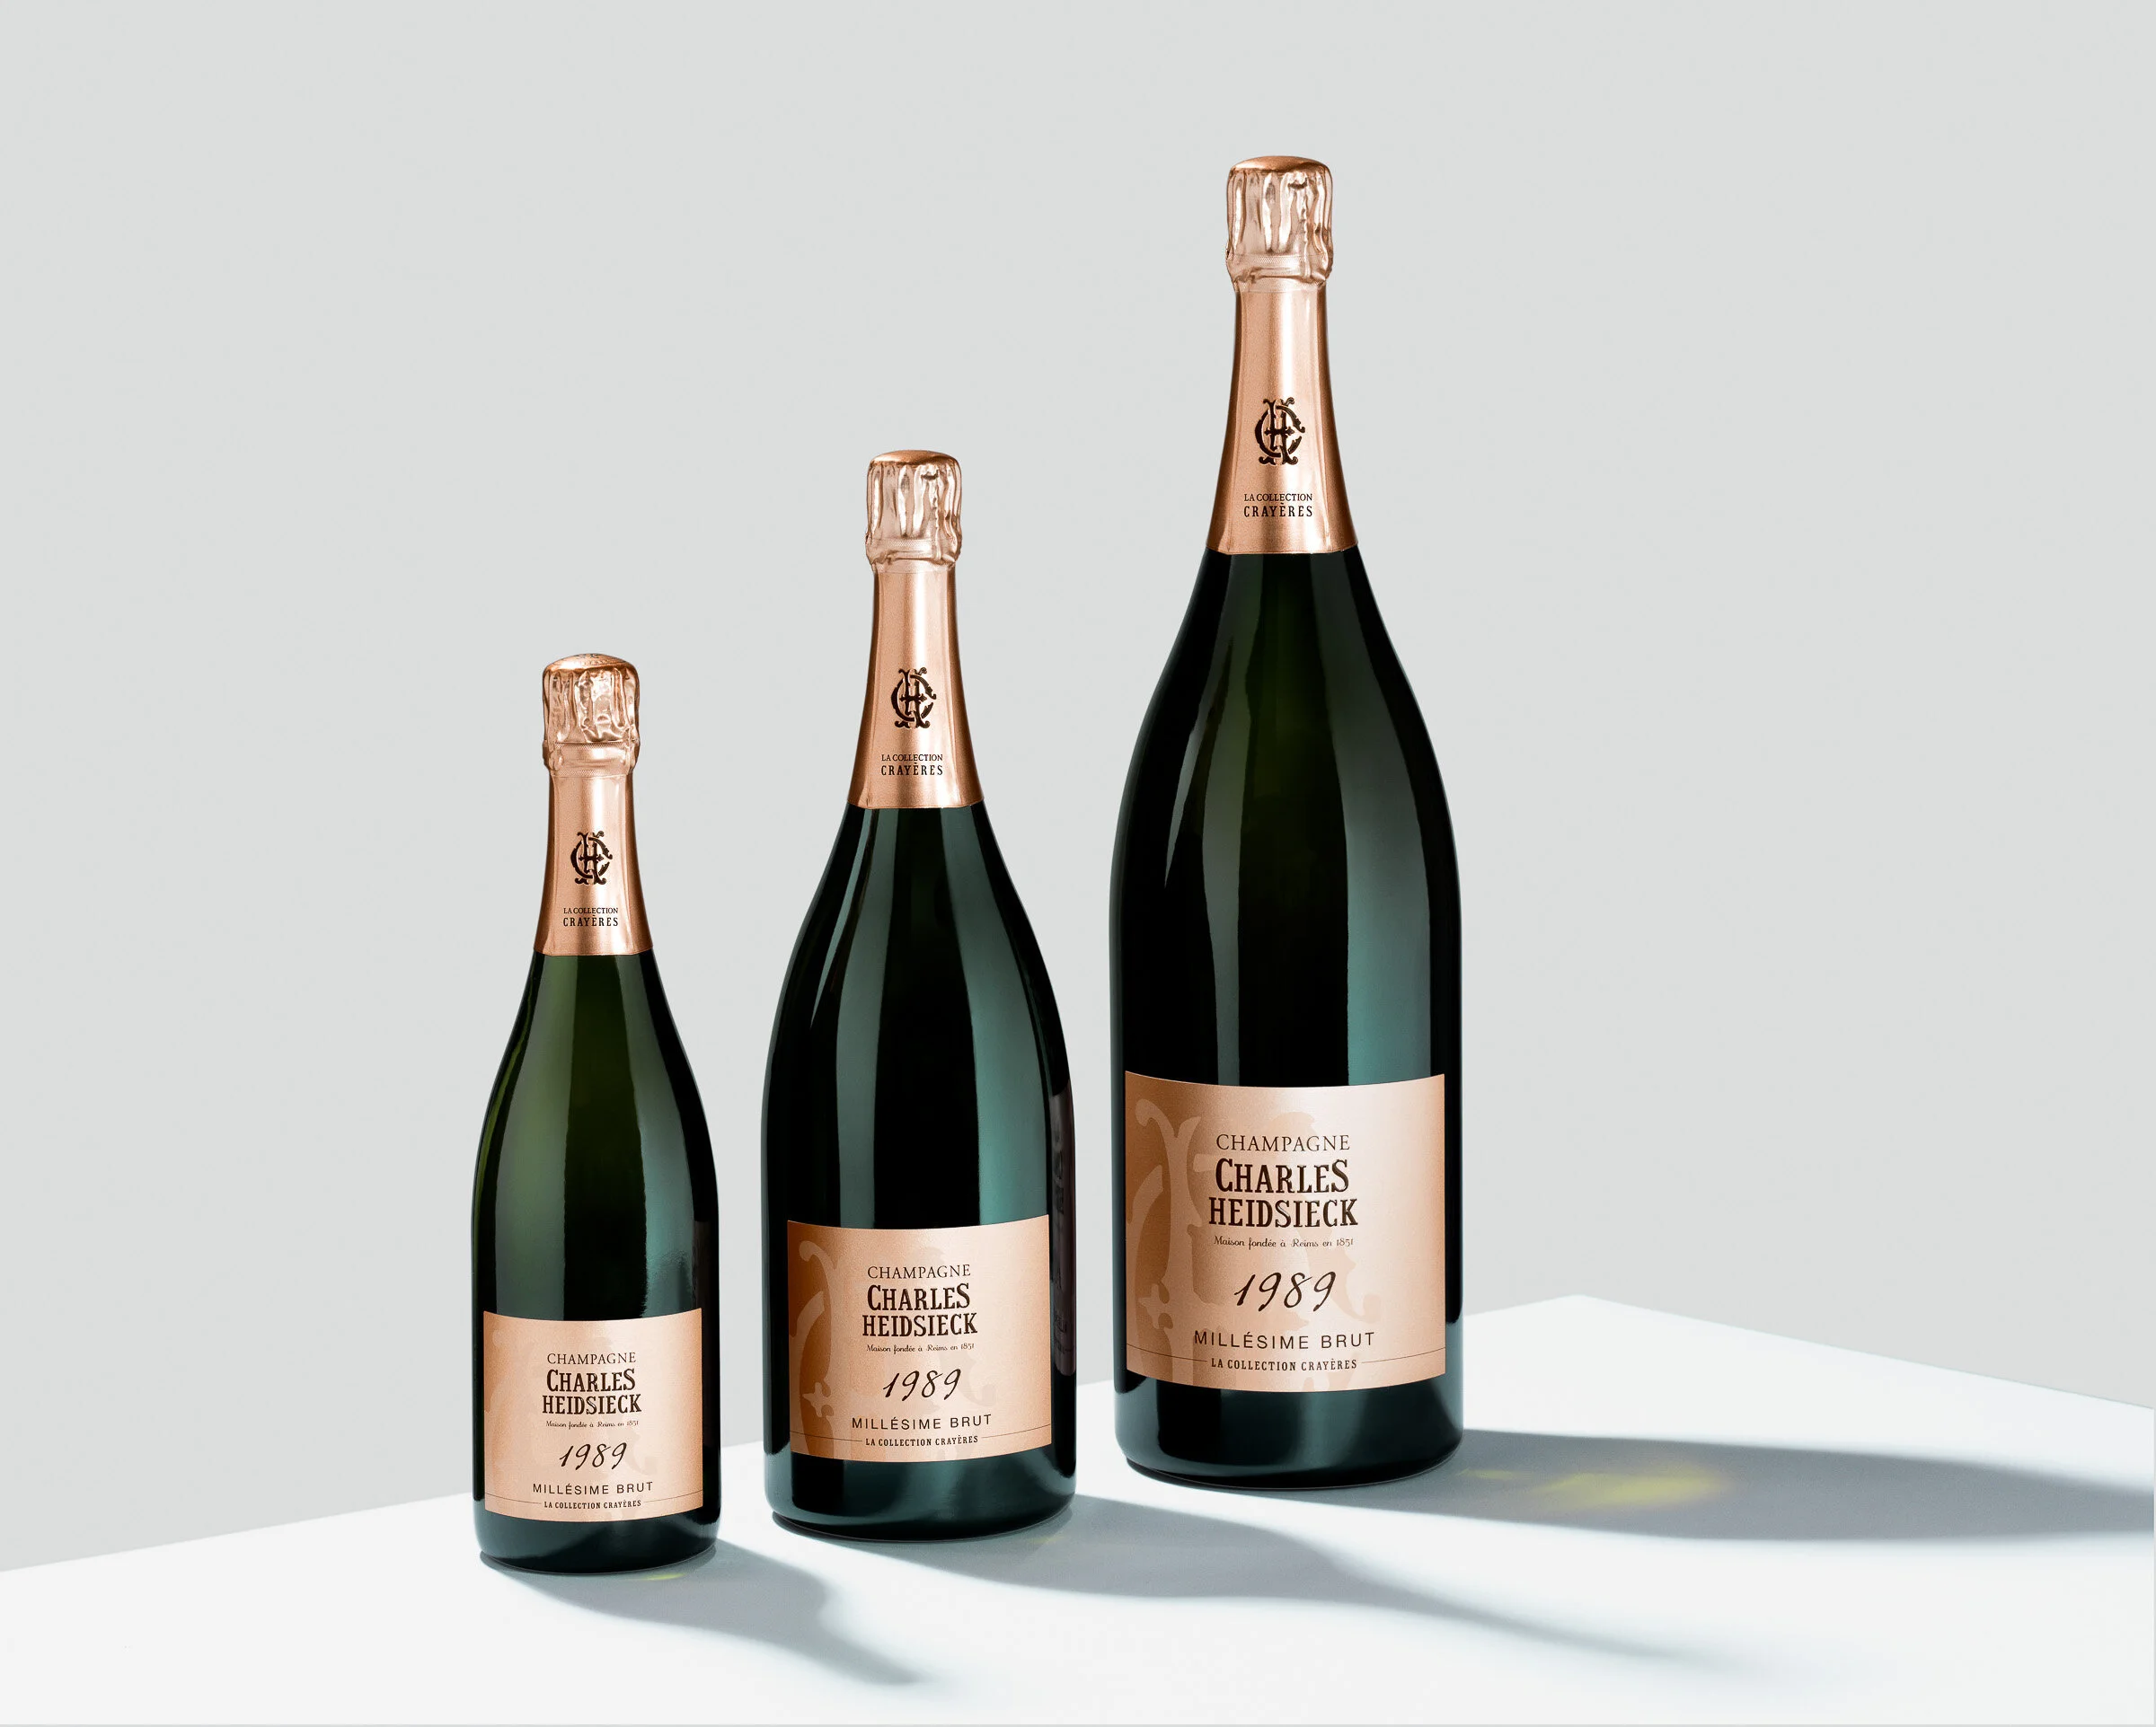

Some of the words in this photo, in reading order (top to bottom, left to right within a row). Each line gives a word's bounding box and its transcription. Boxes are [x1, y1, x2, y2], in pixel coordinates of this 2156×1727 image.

[1243, 493, 1256, 502] LA
[1256, 493, 1313, 502] COLLECTION
[1243, 502, 1313, 517] CRAYÈRES
[881, 753, 892, 762] LA
[892, 753, 943, 762] COLLECTION
[880, 762, 943, 776] CRAYÈRES
[562, 914, 619, 927] CRAYÈRES
[1215, 1133, 1351, 1152] CHAMPAGNE
[1215, 1159, 1348, 1194] CHARLES
[1209, 1197, 1358, 1228] HEIDSIECK
[1213, 1235, 1246, 1247] Maison
[1248, 1237, 1277, 1251] fondée
[1279, 1239, 1286, 1248] à
[1290, 1238, 1320, 1248] Reims
[1336, 1237, 1354, 1247] 1851
[867, 1264, 971, 1280] CHAMPAGNE
[868, 1282, 970, 1310] CHARLES
[1234, 1272, 1336, 1312] 1989
[862, 1312, 977, 1336] HEIDSIECK
[1194, 1330, 1309, 1350] MILLÉSIME
[1321, 1331, 1375, 1349] BRUT
[546, 1352, 637, 1365] CHAMPAGNE
[1211, 1357, 1224, 1369] LA
[1227, 1359, 1296, 1371] COLLECTION
[1301, 1357, 1357, 1371] CRAYÈRES
[547, 1369, 635, 1392] CHARLES
[883, 1369, 961, 1401] 1989
[543, 1394, 641, 1414] HEIDSIECK
[852, 1415, 941, 1431] MILLÉSIME
[950, 1413, 992, 1429] BRUT
[865, 1438, 876, 1447] LA
[878, 1438, 932, 1447] COLLECTION
[934, 1434, 978, 1446] CRAYÈRES
[560, 1442, 627, 1470] 1989
[533, 1483, 609, 1495] MILLÉSIME
[616, 1481, 653, 1494] BRUT
[543, 1501, 553, 1509] LA
[554, 1502, 601, 1510] COLLECTION
[603, 1499, 641, 1510] CRAYÈRES
